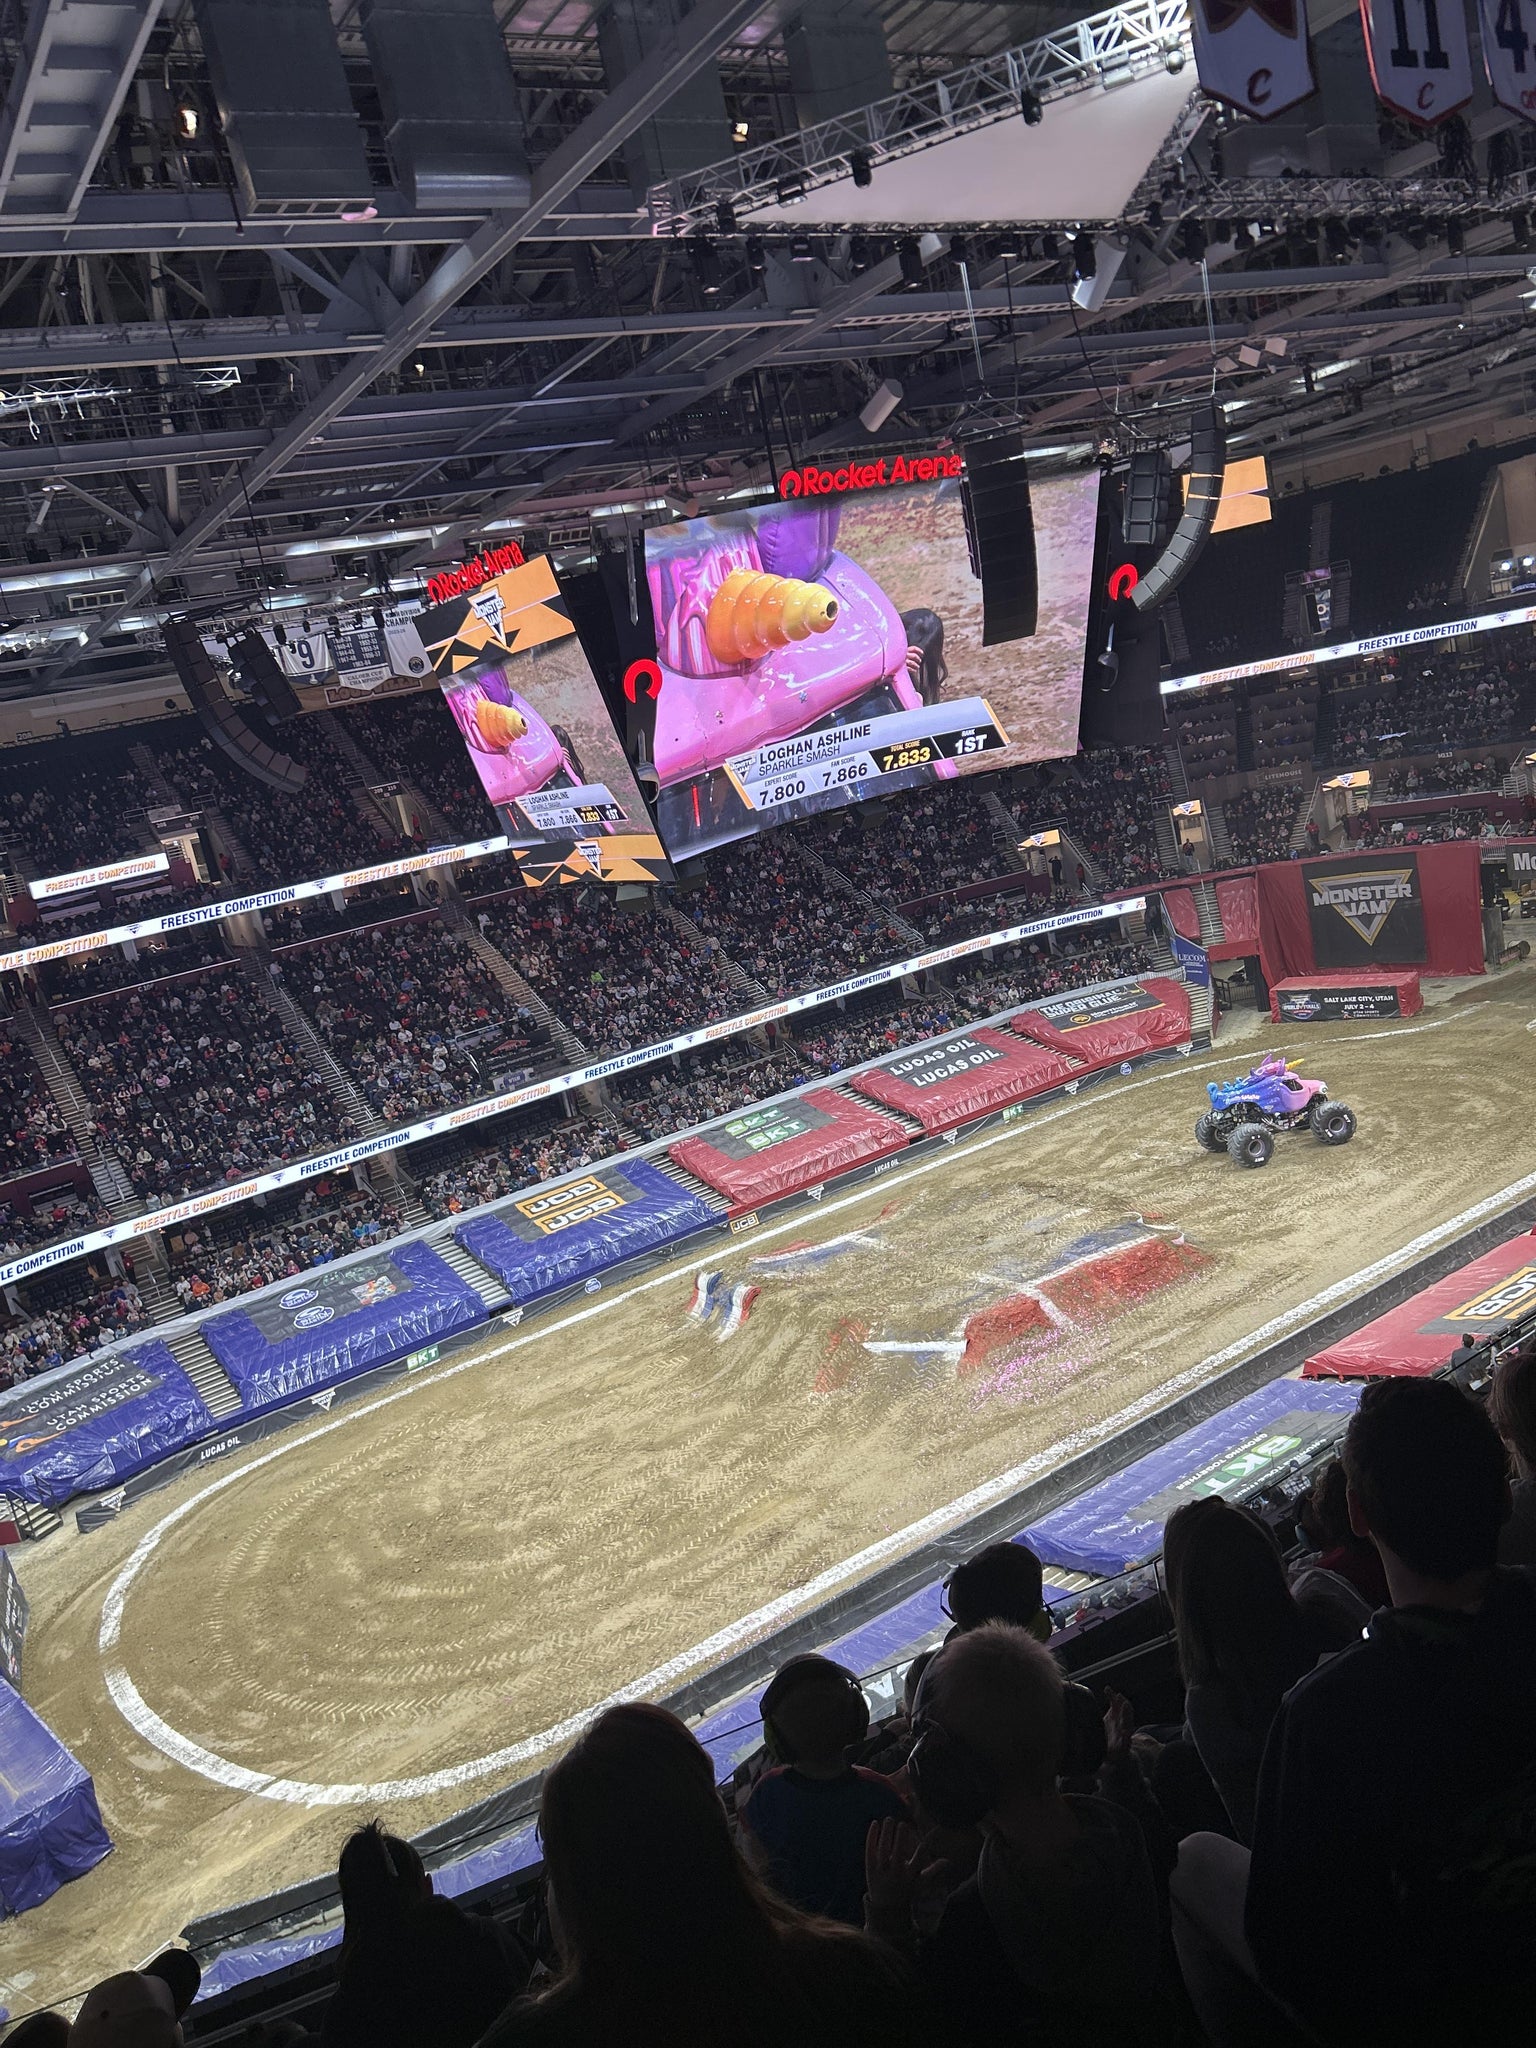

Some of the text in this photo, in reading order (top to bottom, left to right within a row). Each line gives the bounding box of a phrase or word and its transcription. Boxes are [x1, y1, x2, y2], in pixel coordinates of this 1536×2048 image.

[803, 454, 962, 496] Rocket Arena
[437, 541, 525, 600] Rocket Arena
[1358, 620, 1478, 652] FREESTYLE COMPETITION
[1199, 653, 1315, 685] FREESTYLE COMPETITION
[760, 724, 871, 765] LOGHAN ASHLINE
[883, 747, 931, 771] 7.833
[954, 734, 988, 755] 1ST
[759, 754, 803, 777] SPARKLE
[806, 745, 840, 762] SMASH
[822, 762, 868, 787] 7.866
[830, 756, 856, 768] FAN SCORE
[759, 780, 806, 806] 7.800
[764, 771, 798, 787] EXPERT SCORE
[45, 859, 156, 893] FREESTYLE COMPETITION
[343, 848, 466, 886] FREESTYLE COMPETITION
[161, 888, 295, 929] FREESTYLE COMPETITION
[1312, 883, 1413, 906] MONSTER
[1343, 899, 1388, 917] JAM
[1020, 908, 1103, 936] FREESTYLE COMPETITION
[26, 933, 108, 963] COMPETITION
[1178, 953, 1206, 962] LECOM
[816, 970, 891, 1001] FREESTYLE COMPETITION
[1357, 995, 1375, 1003] CITY,
[585, 1042, 674, 1079] FREESTYLE COMPETITION
[889, 1038, 978, 1076] LUCAS OIL
[912, 1049, 1001, 1087] LUCAS OIL
[449, 1084, 551, 1126] FREESTYLE COMPETITION
[1003, 1105, 1024, 1119] BKT
[300, 1131, 411, 1176] FREESTYLE COMPETITION
[874, 1158, 900, 1174] LUCAS OIL
[132, 1183, 258, 1232] FREESTYLE COMPETITION
[733, 1215, 757, 1231] JCB
[16, 1240, 85, 1275] COMPETITION
[407, 1346, 439, 1368] BKT
[47, 1373, 146, 1425] UTAH SPORTS
[56, 1377, 152, 1431] COMMISSION
[200, 1436, 241, 1460] LUCAS OIL
[1176, 1433, 1268, 1491] GROWING TOGETHER
[1204, 1435, 1298, 1495] BKT
